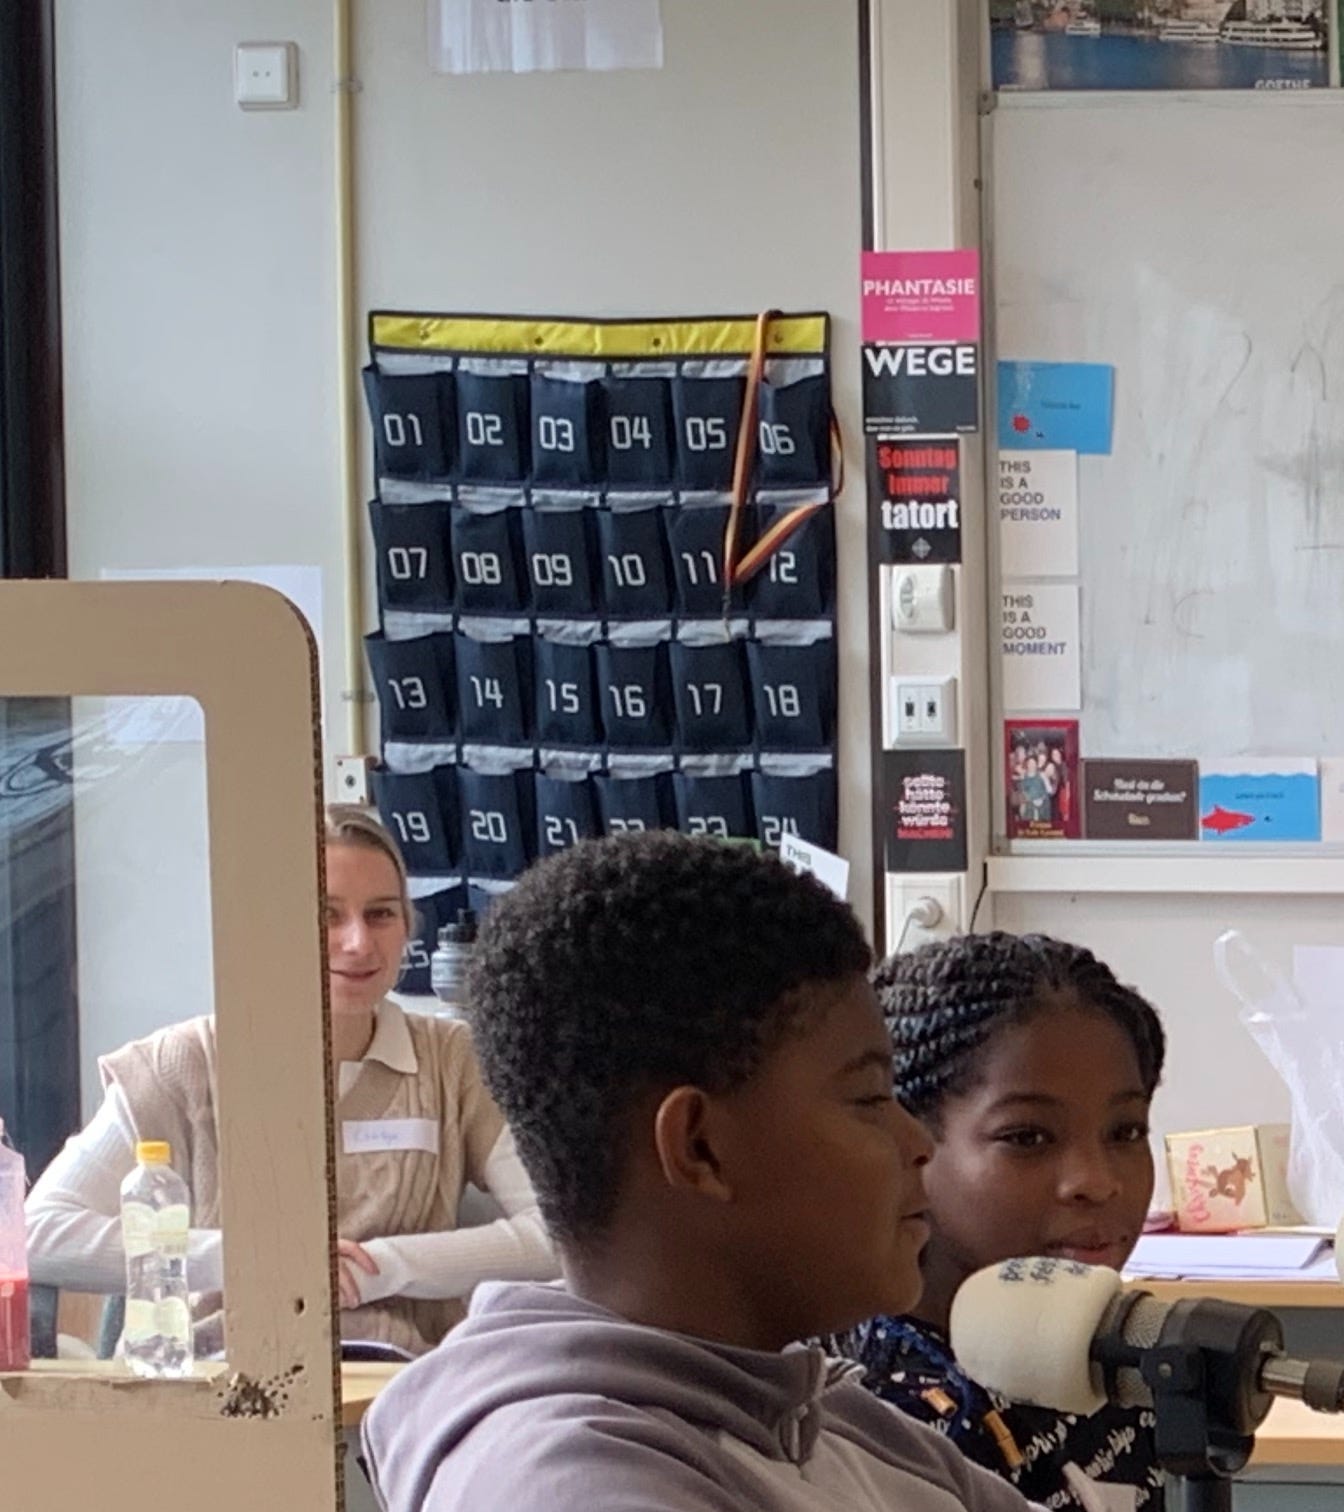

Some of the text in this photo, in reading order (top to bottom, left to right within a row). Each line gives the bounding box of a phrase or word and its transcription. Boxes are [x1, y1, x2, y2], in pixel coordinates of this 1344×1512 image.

[864, 278, 975, 297] PHANTASIE
[864, 347, 976, 376] WEGE
[384, 412, 796, 455] 01 02 03 04 05 06
[1000, 460, 1031, 474] THIS
[1000, 476, 1028, 489] IS A
[1000, 492, 1045, 505] GOOD
[881, 499, 959, 530] tatort
[1000, 507, 1061, 521] PERSON
[388, 547, 797, 586] 07 08 09 10 11 12
[1002, 595, 1033, 608] THIS
[1002, 611, 1031, 624] IS A
[1002, 626, 1047, 640] GOOD
[1002, 642, 1066, 656] MOMENT
[388, 675, 800, 717] 13 14 15 16 17 18
[392, 811, 431, 843] 19
[470, 809, 507, 843] 20
[545, 815, 579, 846] 21
[762, 816, 800, 847] 24
